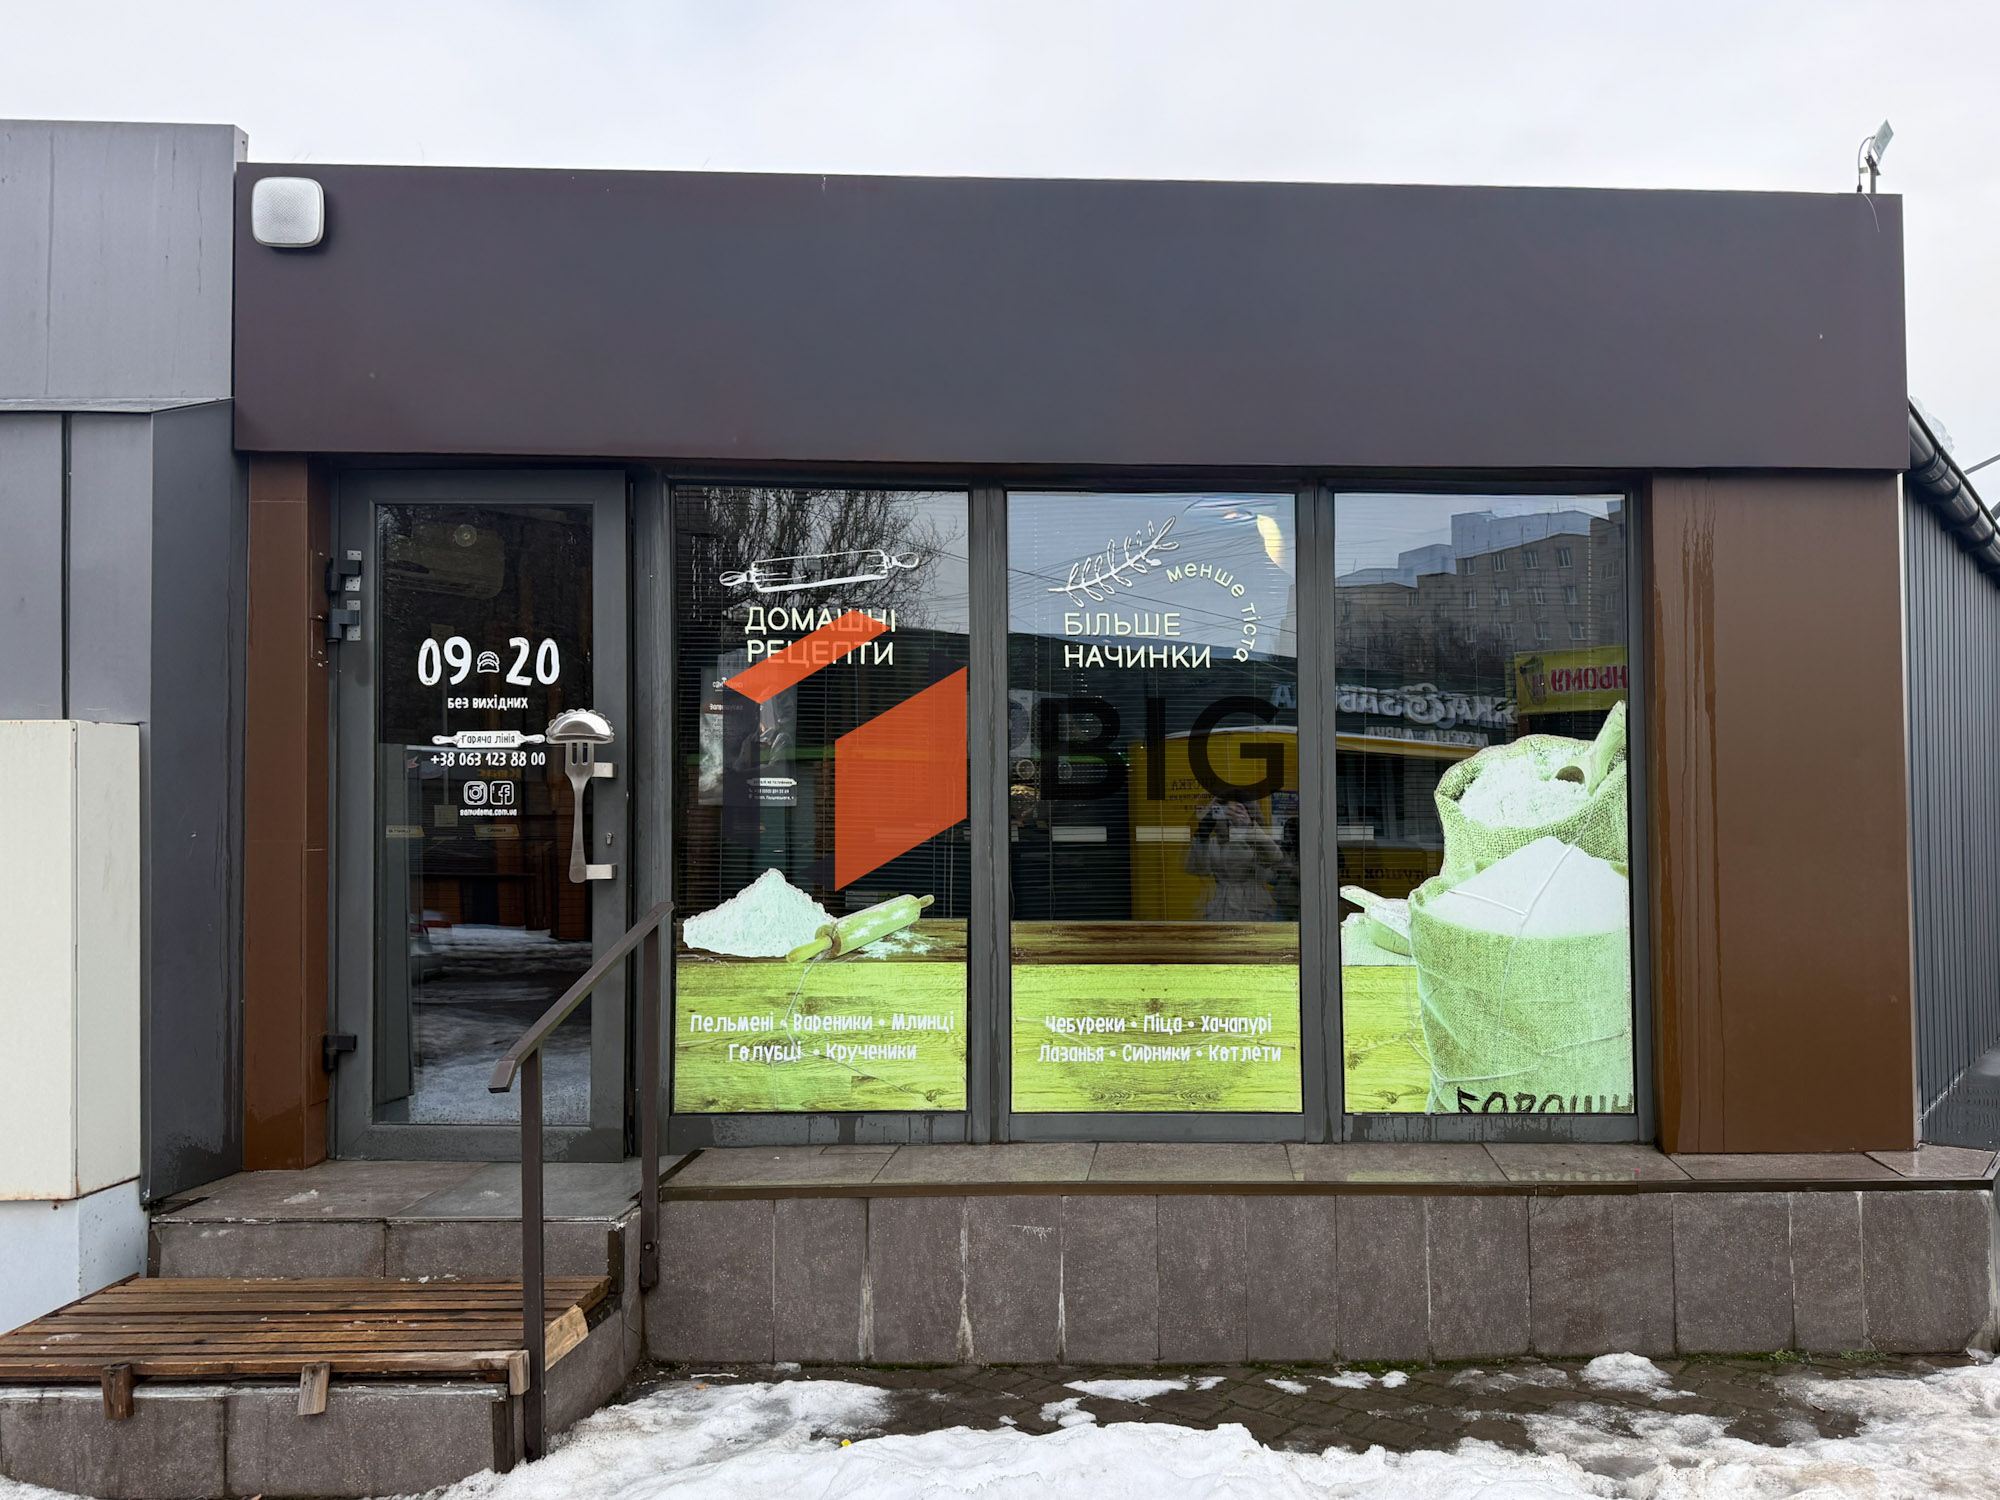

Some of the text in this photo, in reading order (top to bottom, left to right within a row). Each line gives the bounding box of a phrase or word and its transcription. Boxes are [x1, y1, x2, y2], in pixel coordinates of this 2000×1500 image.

[744, 606, 897, 635] ДОМАШНІ
[1063, 612, 1182, 637] БІЛЬШЕ
[1165, 561, 1262, 663] менше тіста
[417, 635, 561, 686] 09 20
[746, 639, 895, 668] РЕЦЕПТИ
[1063, 644, 1212, 669] НАЧИНКИ
[430, 751, 547, 767] +38 063 123 88 00
[689, 1011, 955, 1033] Пельмені Вареники Млинці
[1045, 1013, 1272, 1036] Чебуреки Піца Хачапурі
[728, 1041, 918, 1063] Голубці Крученики
[1037, 1044, 1282, 1064] Лазанья Сирники Котлети
